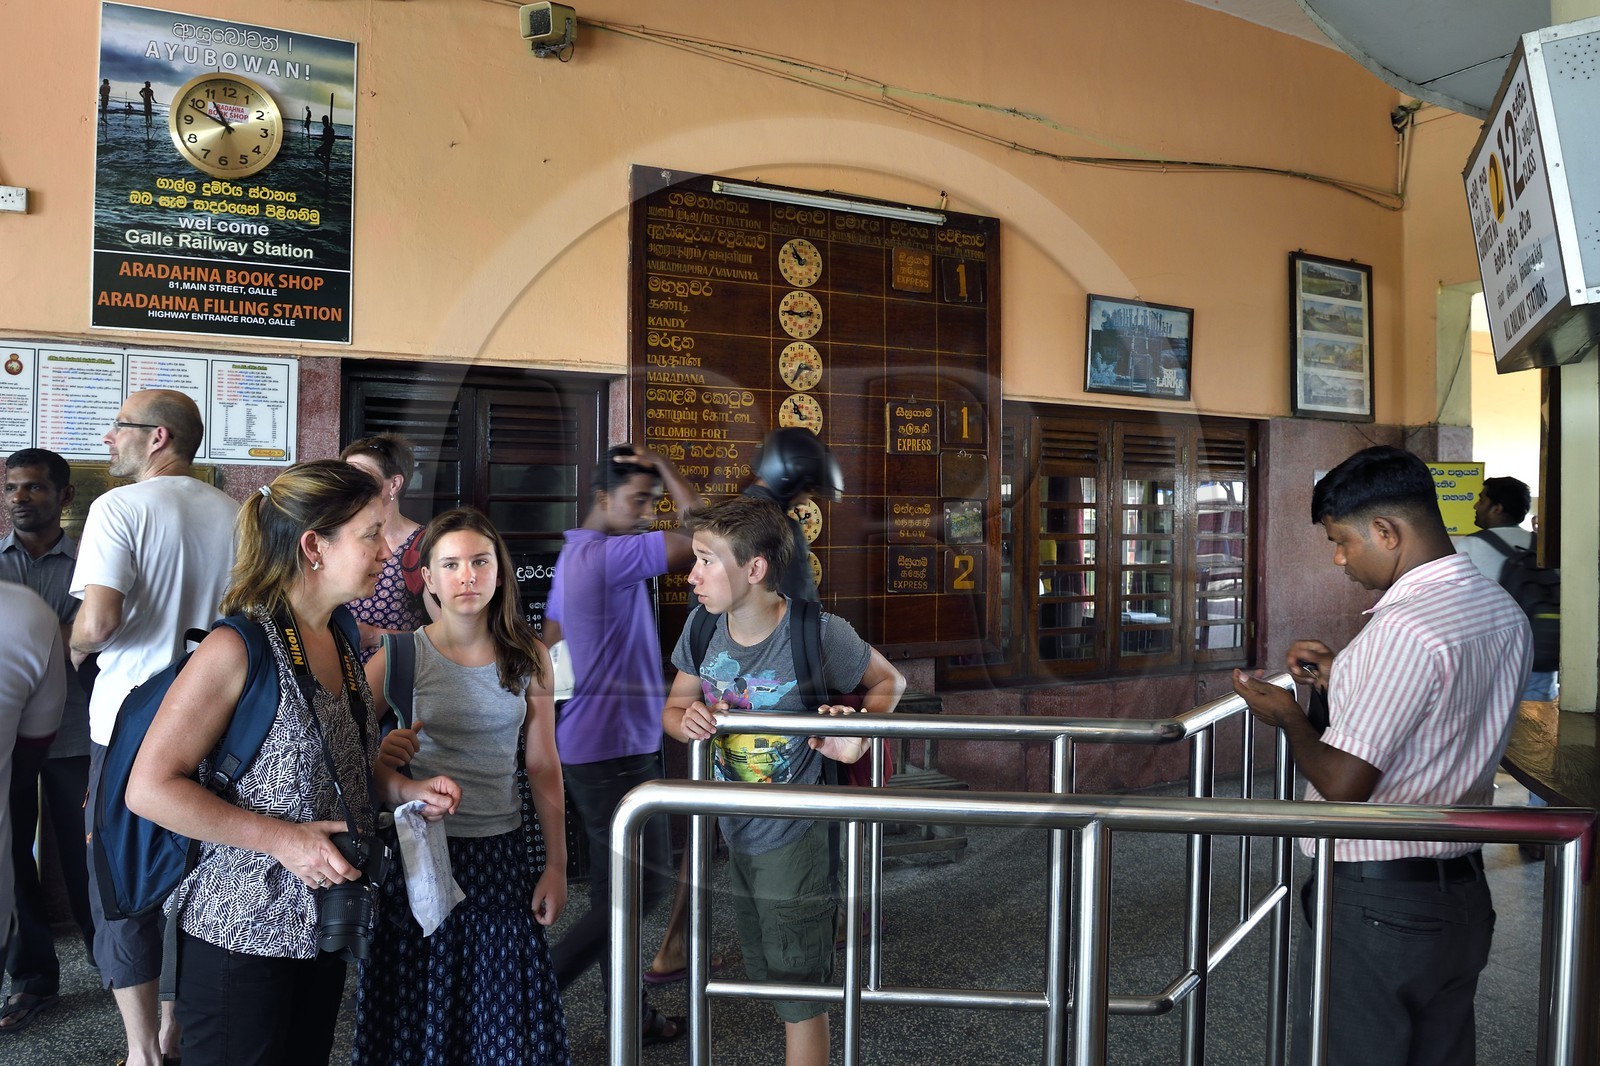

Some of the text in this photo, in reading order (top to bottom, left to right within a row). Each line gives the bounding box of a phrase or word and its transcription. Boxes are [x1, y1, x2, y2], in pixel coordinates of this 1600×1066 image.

[145, 40, 312, 81] AYUBOWAN!
[206, 89, 216, 100] 11
[223, 86, 236, 98] 12
[190, 98, 206, 109] 10
[244, 95, 250, 105] 1
[214, 104, 244, 113] RADAHNA
[184, 115, 194, 125] 9
[230, 112, 248, 120] SHOP
[256, 110, 265, 121] 2
[188, 134, 197, 144] 8
[260, 128, 268, 138] 3
[201, 148, 210, 159] 7
[252, 145, 262, 156] 4
[218, 156, 228, 166] 6
[240, 154, 248, 165] 5
[1523, 149, 1536, 184] CLASS
[1490, 155, 1504, 219] 2
[125, 230, 314, 259] Galle Railway Station
[119, 261, 324, 291] ARADAHNA BOOK SHOP
[897, 275, 928, 288] EXPRESS
[957, 264, 968, 297] 1
[209, 284, 246, 295] STREET,
[248, 286, 278, 296] GALLE
[1526, 278, 1547, 318] STATIONS
[98, 290, 342, 322] ARADAHNA FILLING STATION
[148, 310, 296, 327] HIGHWAY ENTRANCE ROAD, GALLE
[648, 316, 688, 328] KANDY
[646, 372, 705, 384] MARADANA
[962, 406, 968, 440] 1
[647, 426, 728, 439] COLOMBO FORT
[897, 438, 932, 452] EXPRESS
[705, 482, 738, 493] SOUTH
[899, 530, 926, 538] SLOW
[953, 555, 976, 590] 2
[894, 580, 928, 590] EXPRESS
[285, 628, 304, 666] Nikon
[343, 655, 358, 692] Nikon
